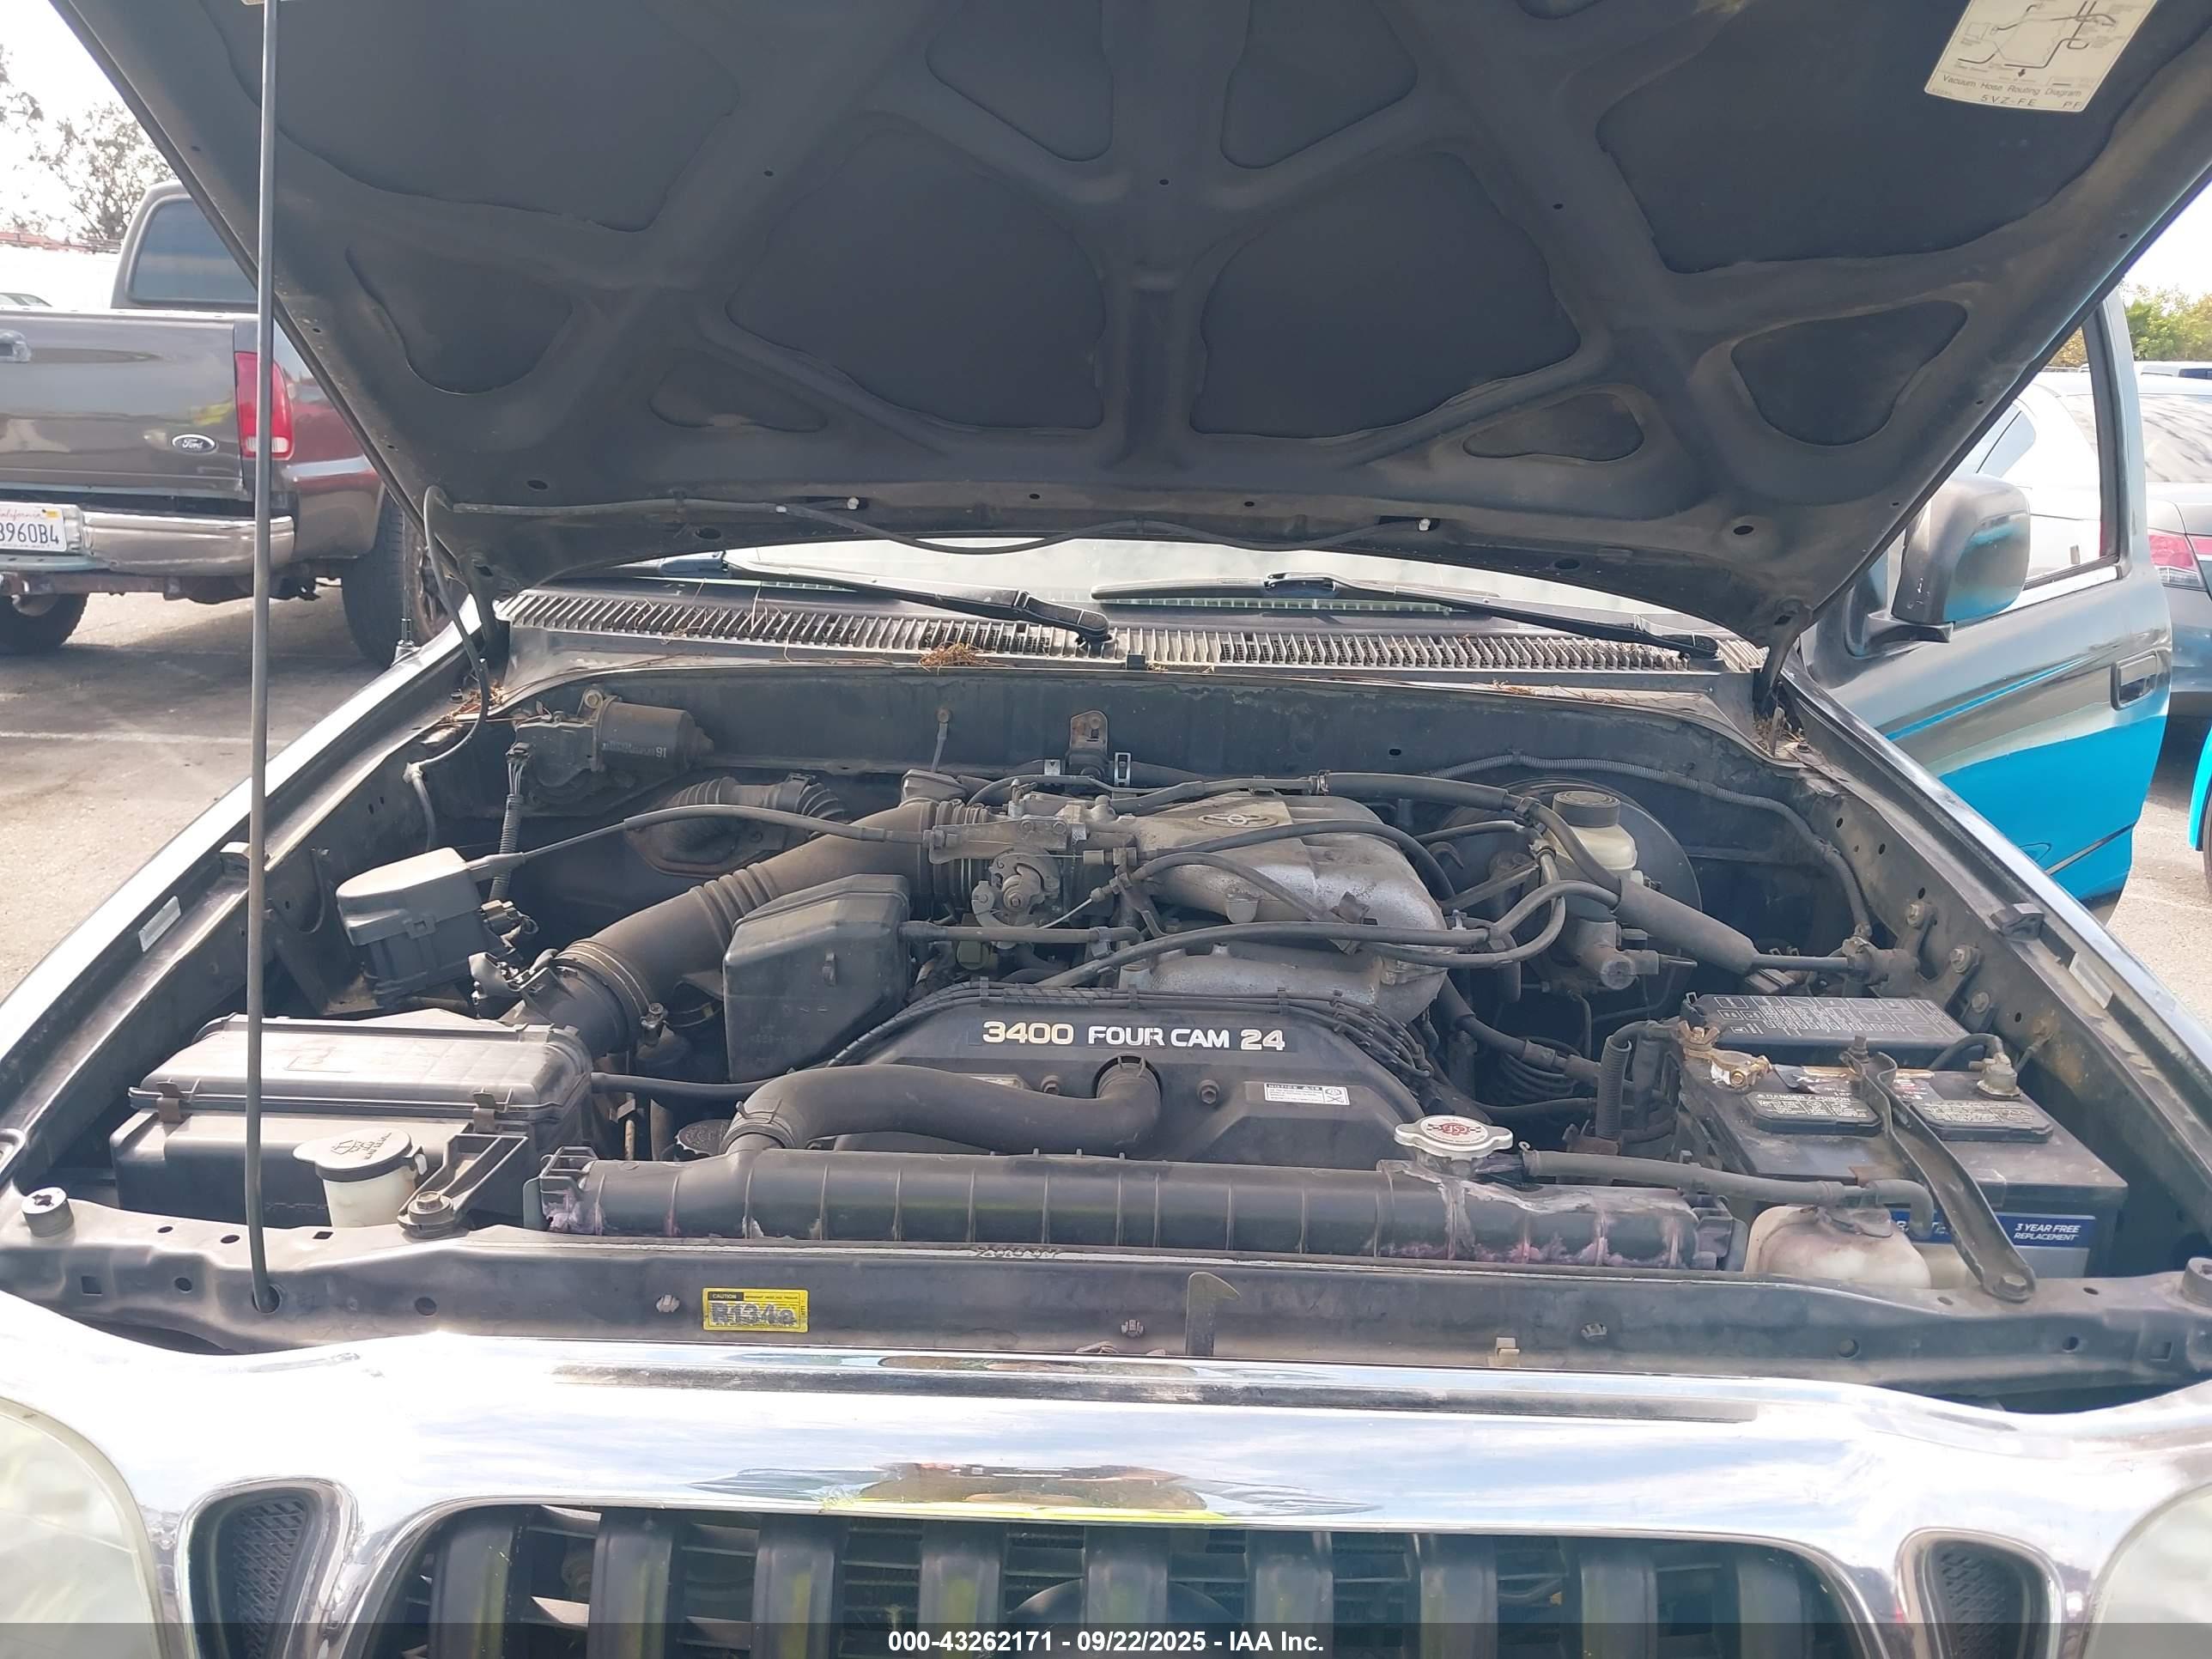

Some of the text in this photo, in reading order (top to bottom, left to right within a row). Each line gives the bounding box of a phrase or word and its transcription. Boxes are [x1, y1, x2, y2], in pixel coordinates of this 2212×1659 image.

[1943, 75, 2082, 97] Vacuum Hose Routing Diagram
[0, 508, 41, 521] alifornia
[982, 1020, 1285, 1050] 3400 FOUR CAM 24
[2014, 1223, 2081, 1234] 3 YEAR FREE
[2014, 1232, 2075, 1242] REPLACEMENT
[711, 1303, 797, 1325] R134a
